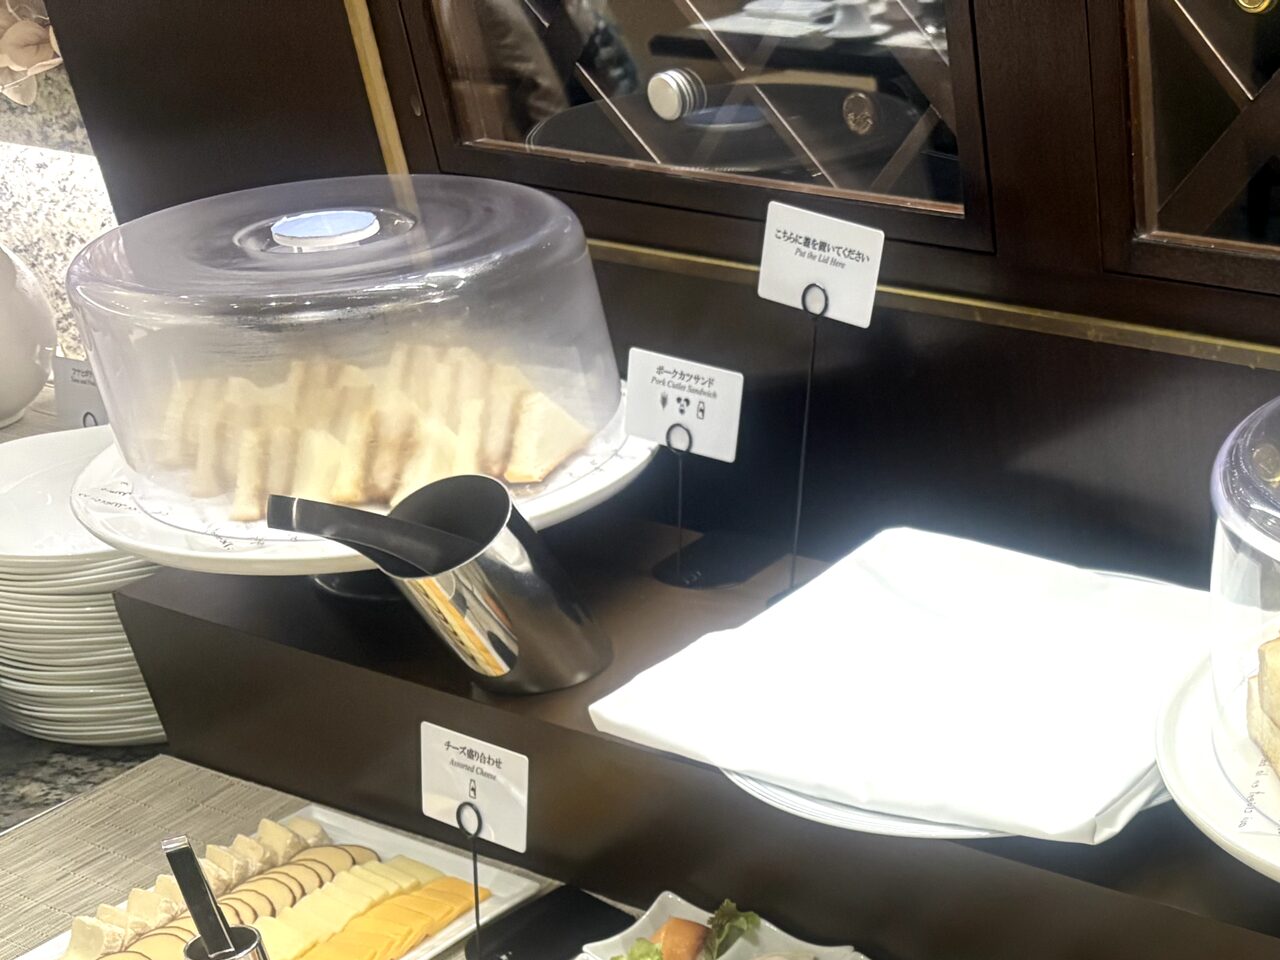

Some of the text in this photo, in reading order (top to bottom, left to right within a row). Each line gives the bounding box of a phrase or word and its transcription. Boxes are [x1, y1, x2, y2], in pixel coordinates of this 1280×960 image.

[656, 366, 715, 388] ポークカツサンド
[444, 741, 502, 769] チーズ盛り合わせ
